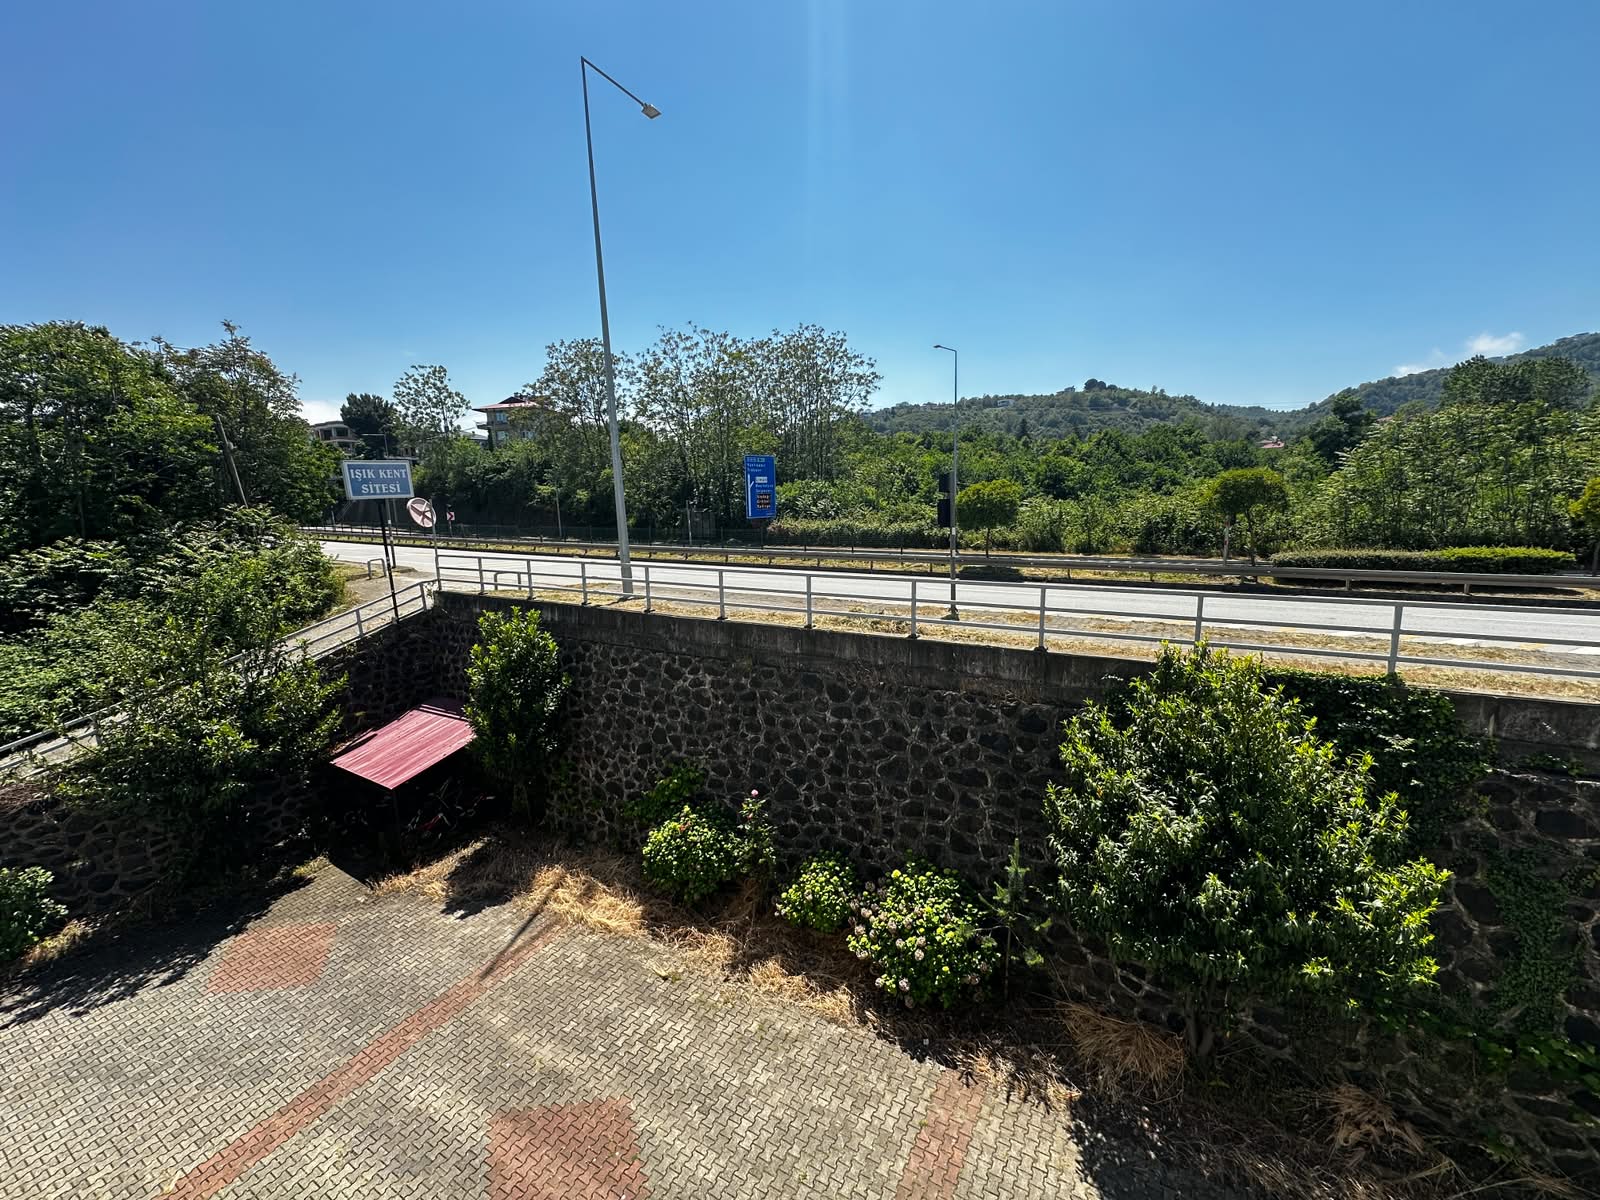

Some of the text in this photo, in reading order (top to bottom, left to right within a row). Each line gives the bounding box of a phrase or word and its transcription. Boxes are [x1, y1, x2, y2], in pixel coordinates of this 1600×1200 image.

[350, 469, 407, 481] IŞIK KENT
[361, 481, 401, 494] SİTESİ
